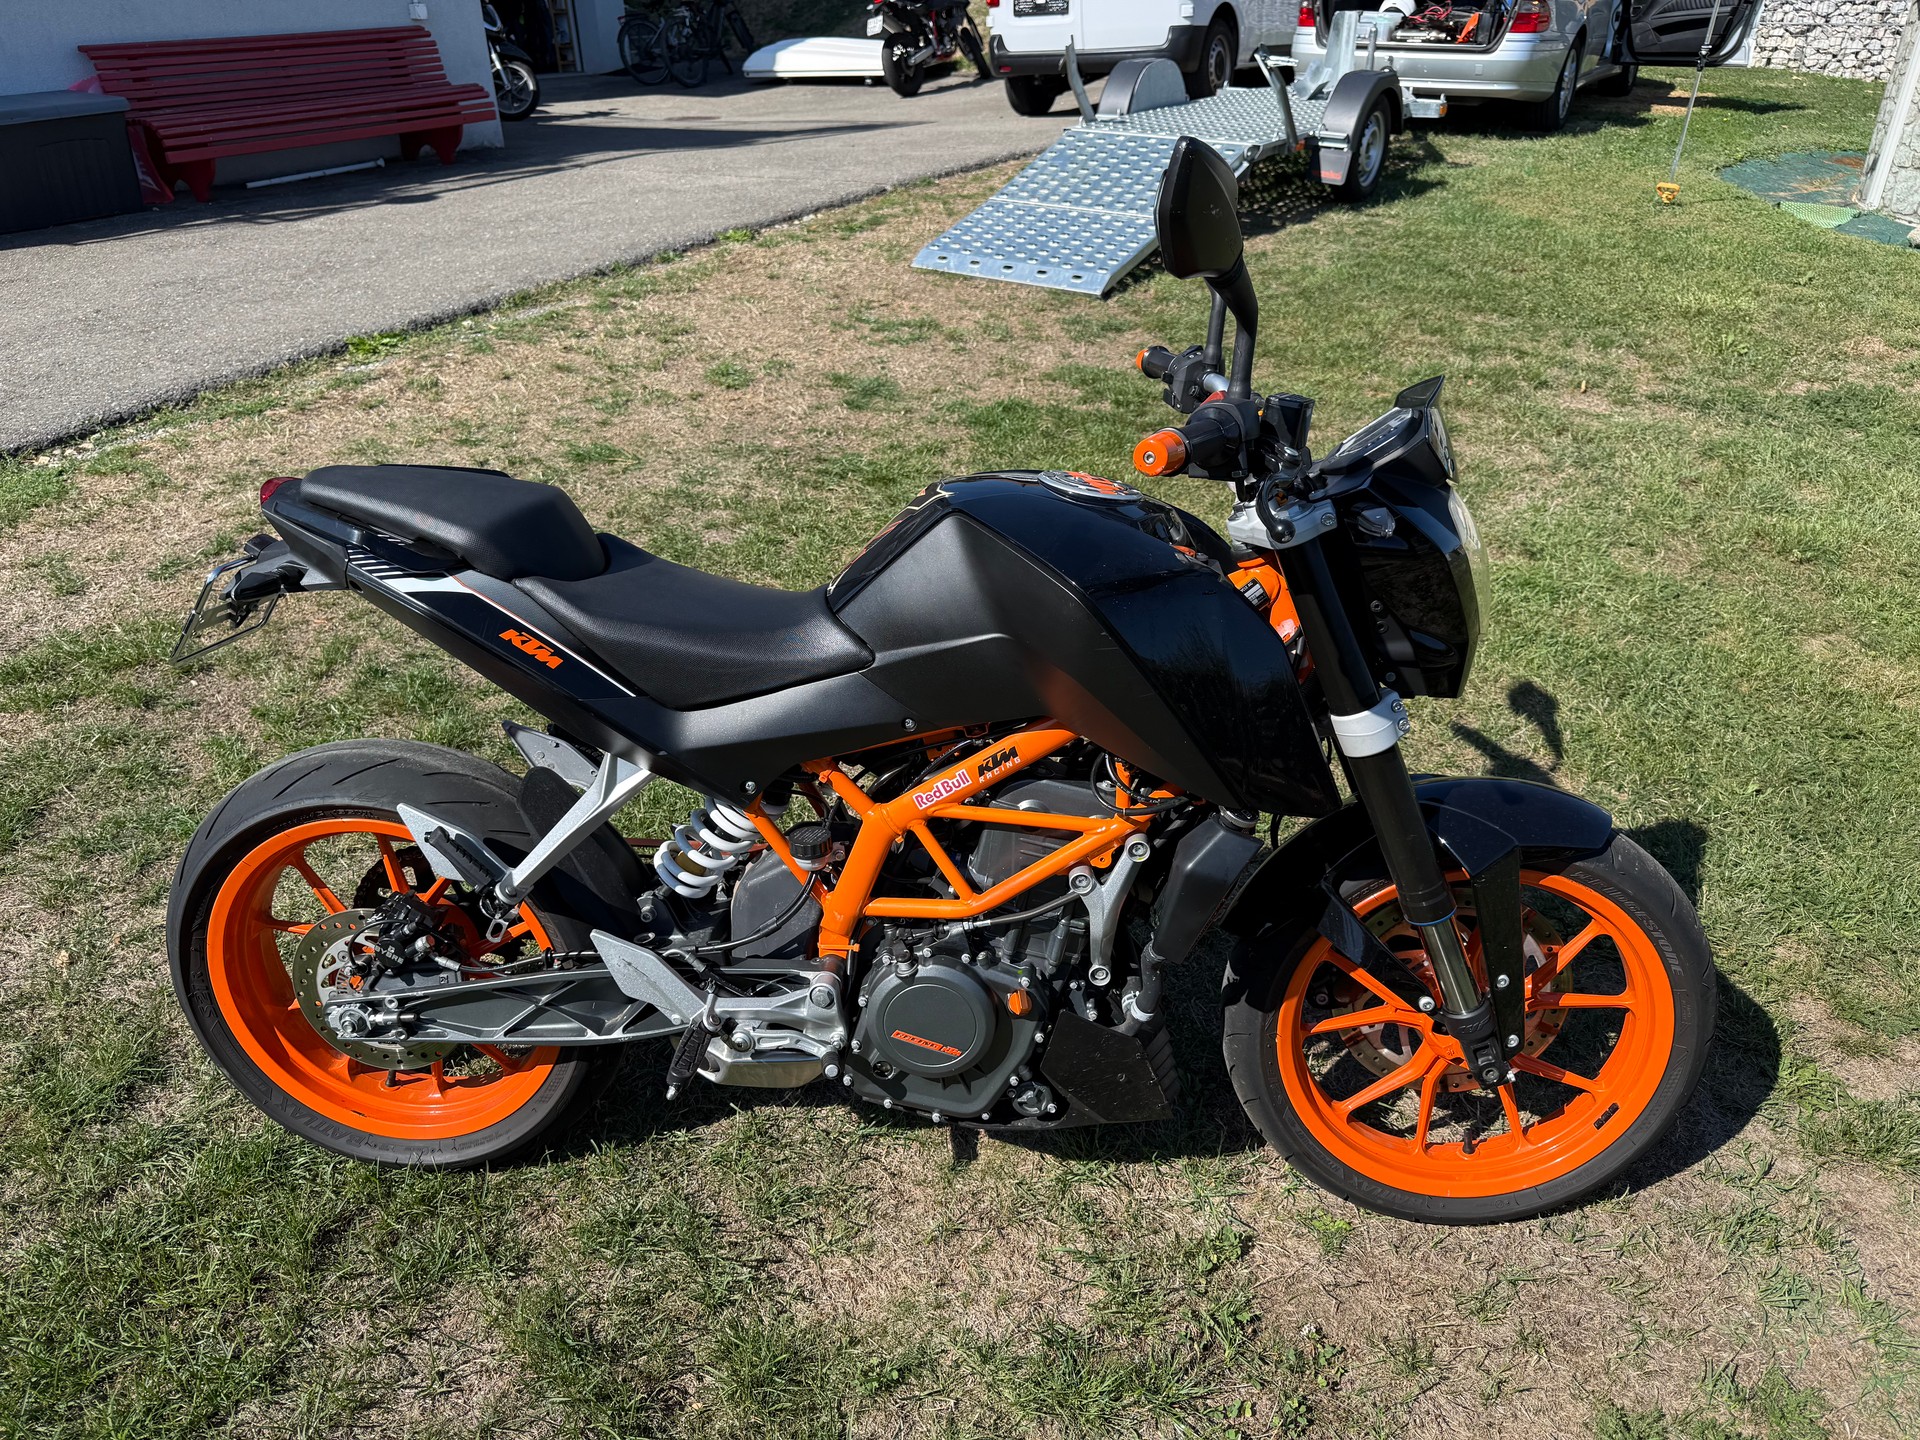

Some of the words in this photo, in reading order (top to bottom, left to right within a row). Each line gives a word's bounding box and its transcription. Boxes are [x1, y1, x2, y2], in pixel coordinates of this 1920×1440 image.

[498, 628, 564, 670] KTM
[977, 746, 1019, 777] KTM
[978, 757, 1021, 784] RACING
